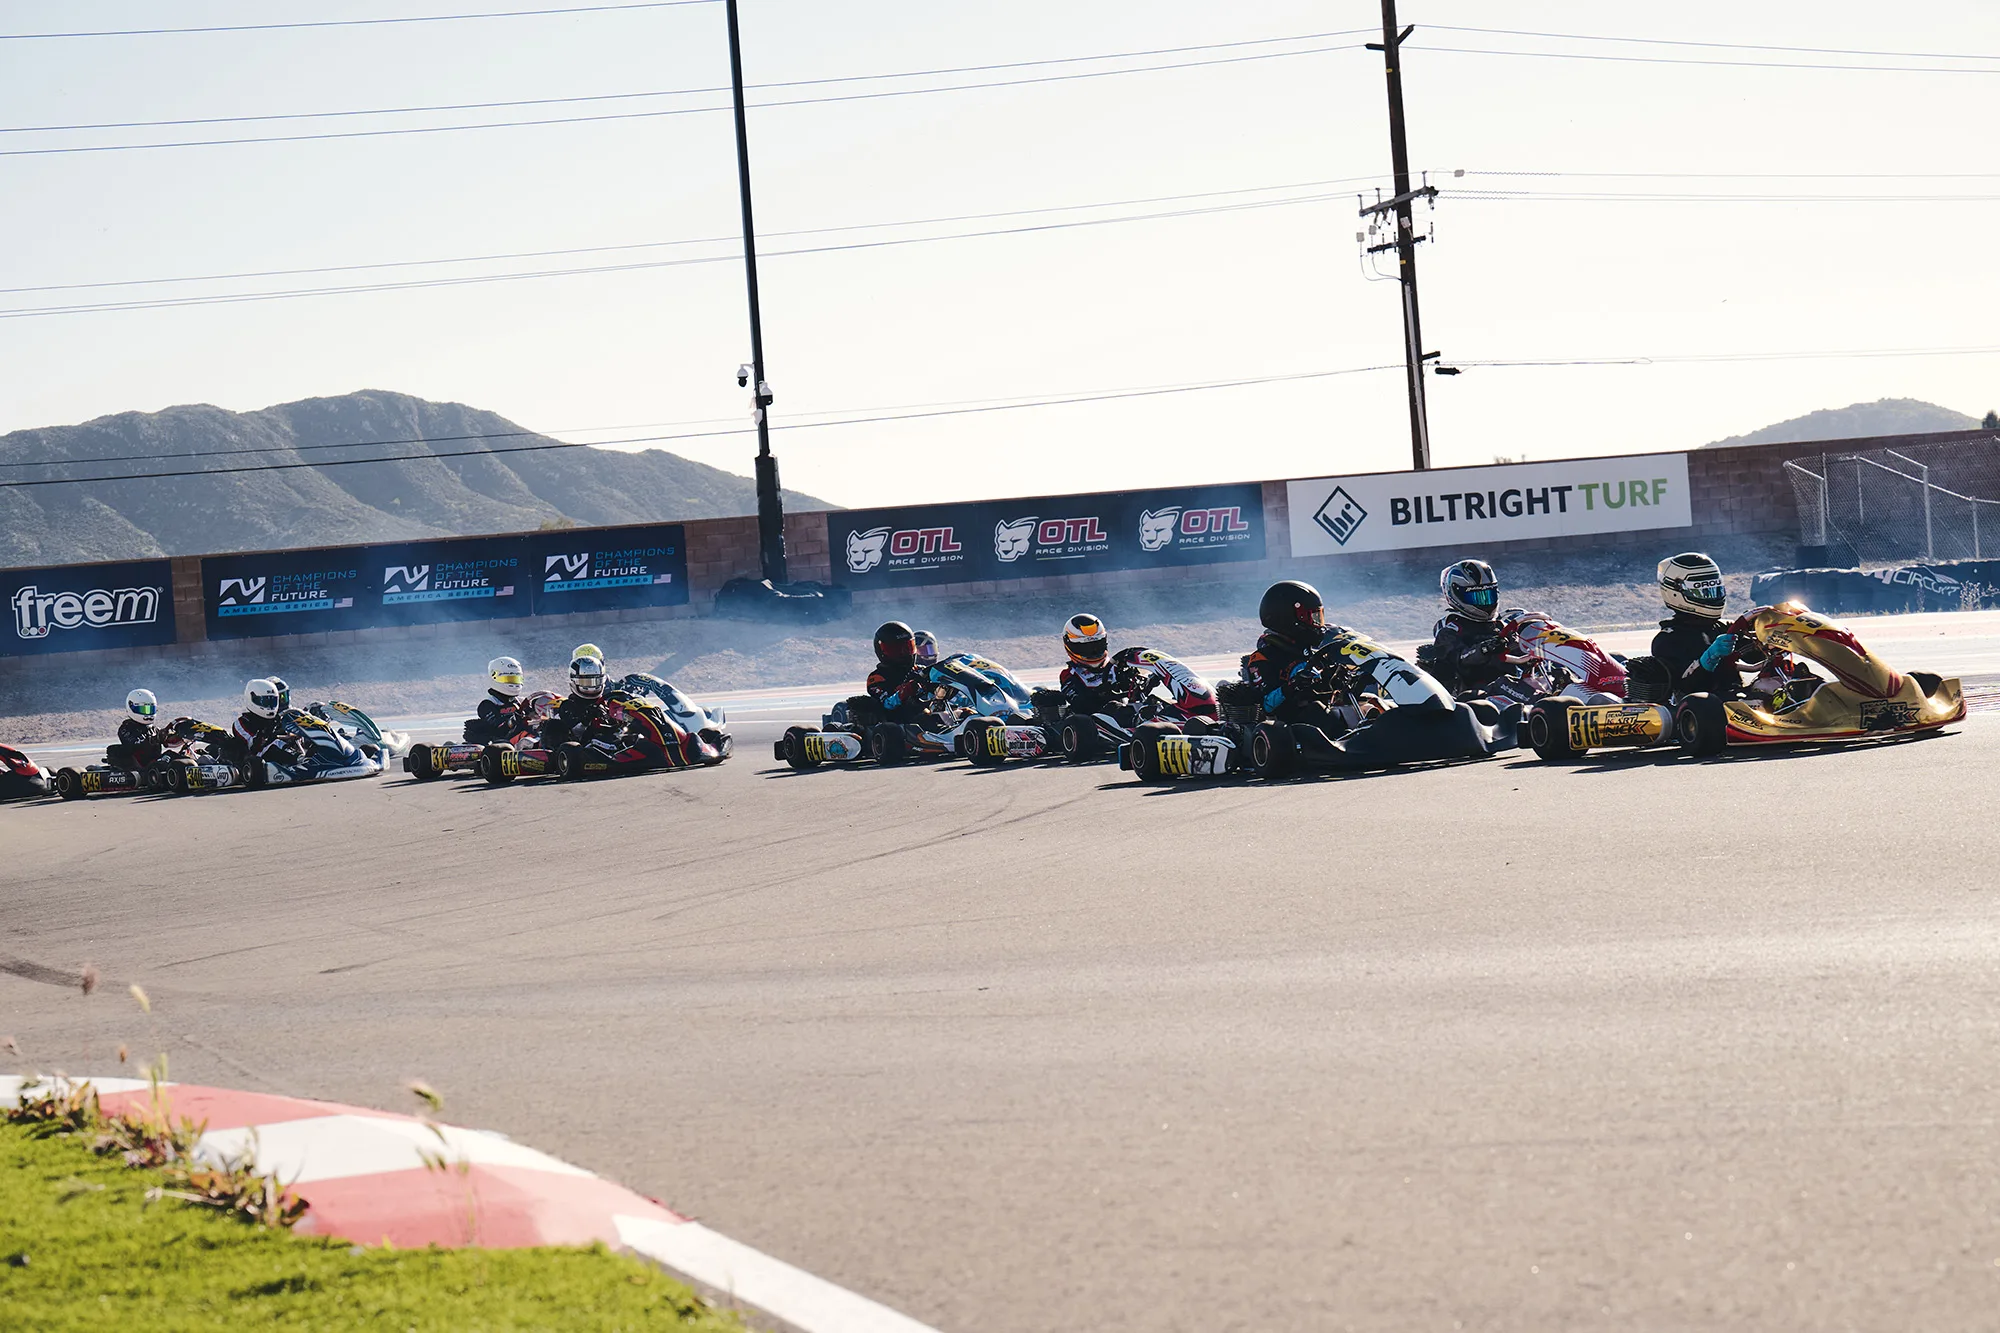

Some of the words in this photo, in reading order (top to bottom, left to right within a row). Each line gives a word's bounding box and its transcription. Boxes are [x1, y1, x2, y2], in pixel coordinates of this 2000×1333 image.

[1390, 485, 1573, 526] BILTRIGHT
[1578, 478, 1667, 511] TURF
[1181, 506, 1249, 535] OTL
[1037, 516, 1107, 545] OTL
[890, 526, 961, 556] OTL
[1179, 536, 1204, 544] RACE
[1210, 533, 1251, 542] DIVISION
[595, 546, 675, 560] CHAMPIONS
[1035, 547, 1062, 555] RACE
[1067, 544, 1109, 553] DIVISION
[436, 558, 518, 572] CHAMPIONS
[595, 559, 612, 569] OF
[616, 557, 641, 567] THE
[888, 558, 916, 566] RACE
[921, 554, 964, 564] DIVISION
[273, 569, 357, 584] CHAMPIONS
[435, 571, 454, 581] OF
[458, 569, 483, 579] THE
[594, 565, 647, 577] FUTURE
[272, 583, 291, 593] OF
[295, 581, 321, 592] THE
[434, 578, 489, 590] FUTURE
[549, 580, 601, 590] AMERICA
[607, 577, 649, 585] SERIES
[271, 589, 328, 602] FUTURE
[388, 592, 441, 601] AMERICA
[447, 588, 490, 598] SERIES
[16, 588, 155, 630] freem
[223, 604, 279, 614] AMERICA
[285, 601, 329, 610] SERIES
[1570, 711, 1601, 747] 315
